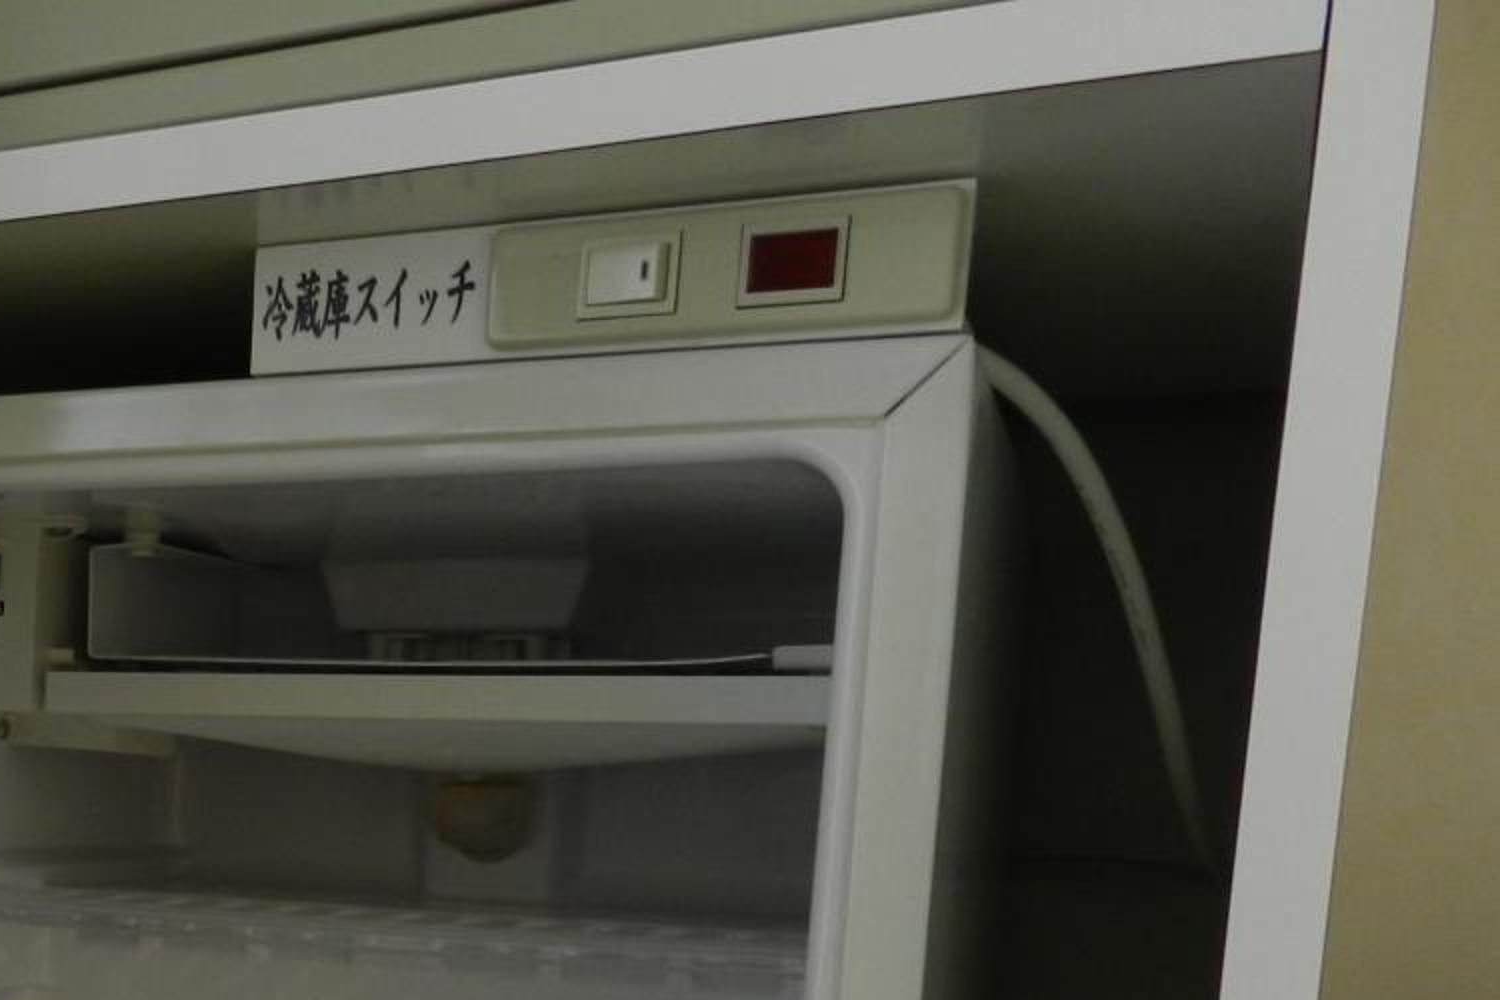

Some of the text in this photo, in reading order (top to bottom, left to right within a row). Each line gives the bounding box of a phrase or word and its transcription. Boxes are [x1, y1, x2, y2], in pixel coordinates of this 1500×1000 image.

[262, 260, 476, 339] 冷蔵庫スイッチ
